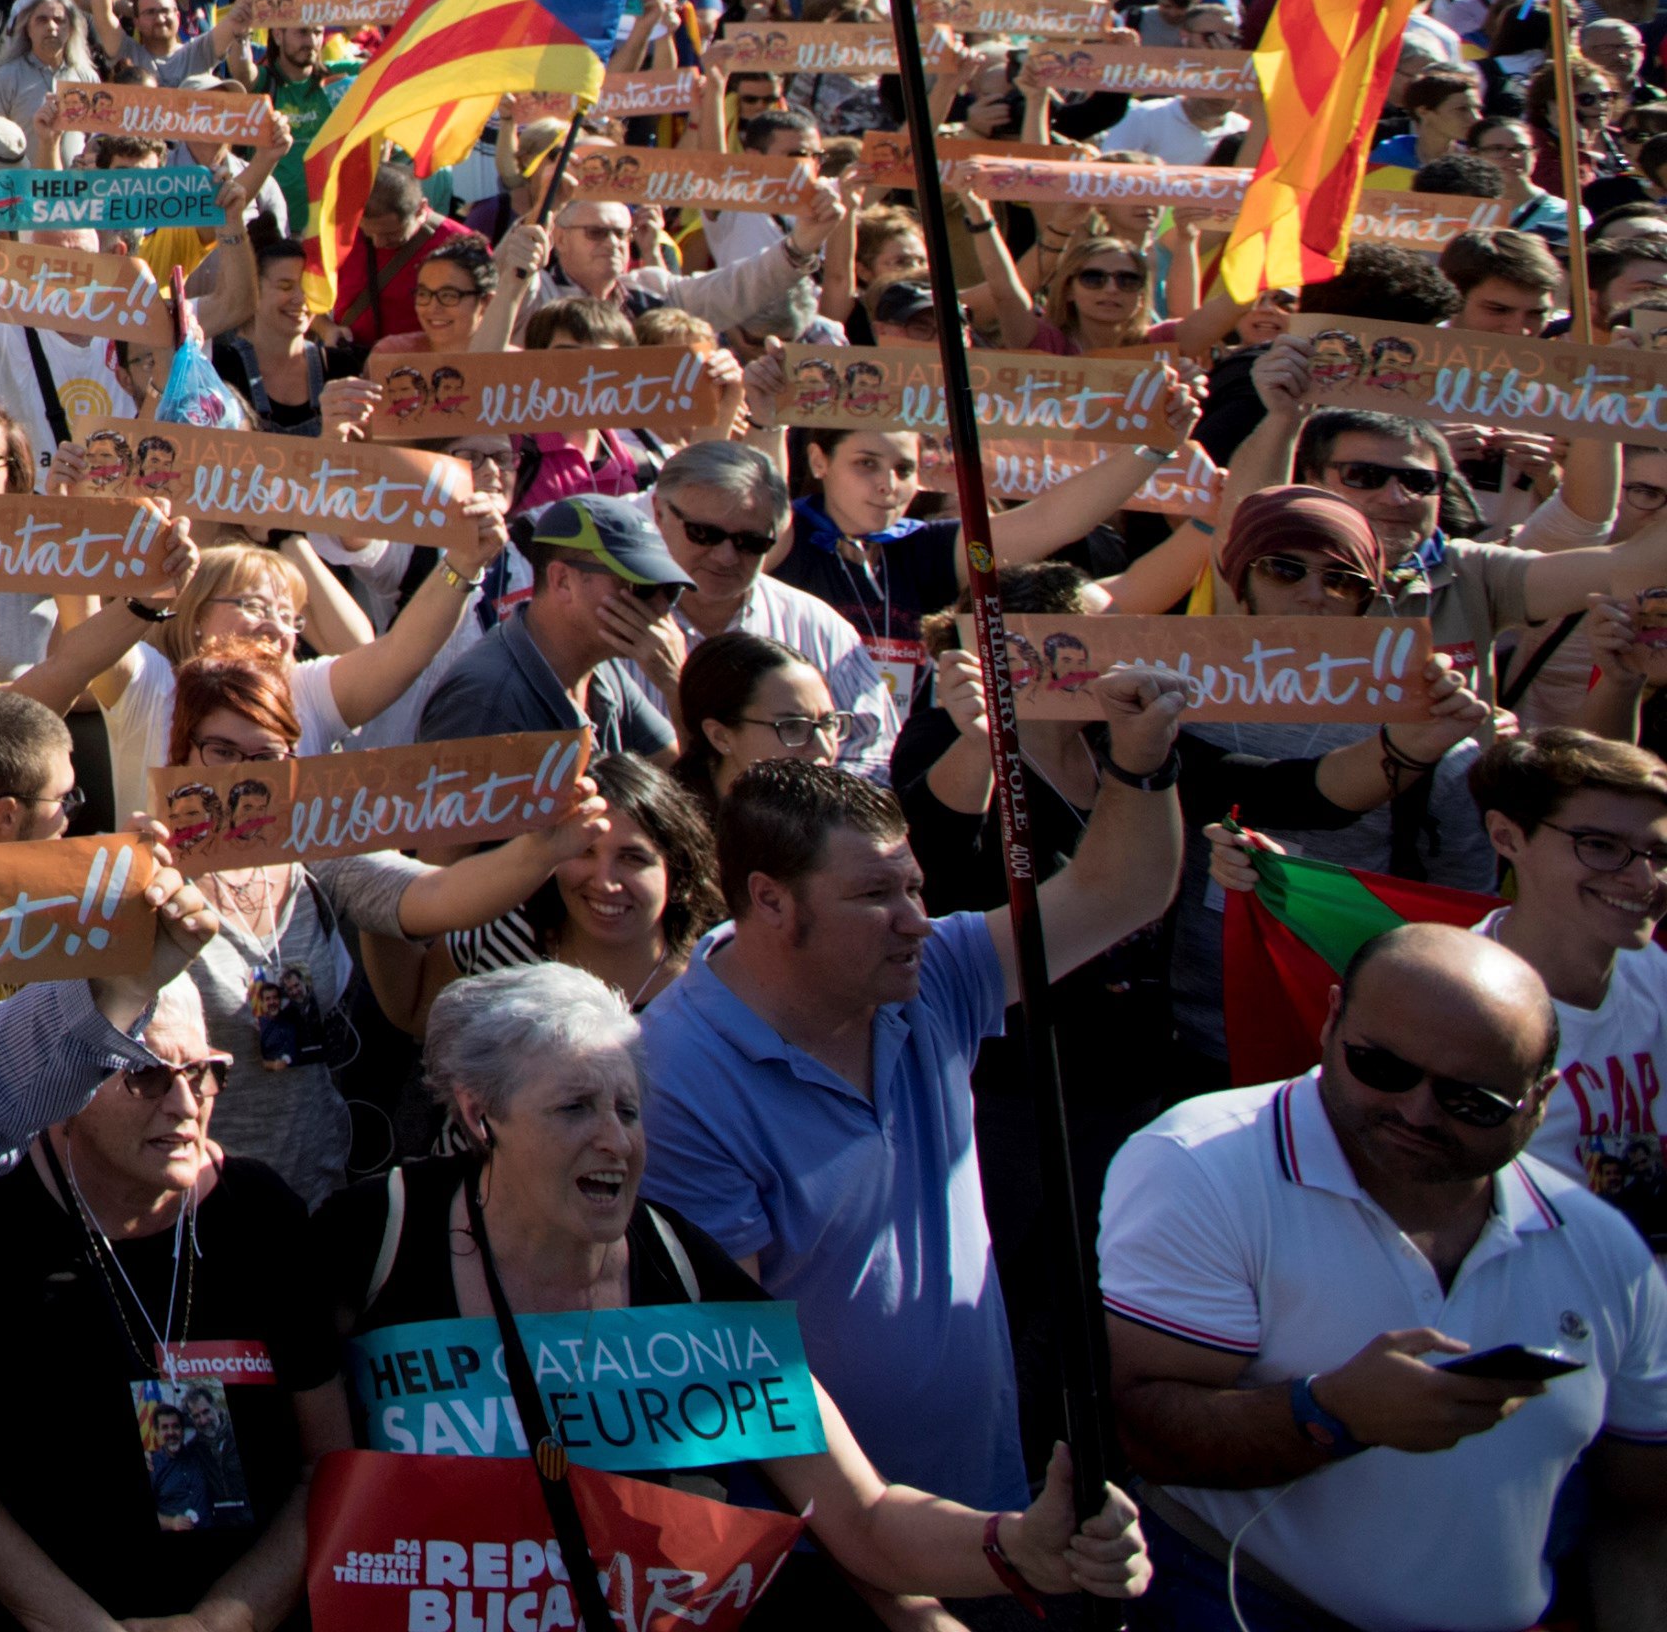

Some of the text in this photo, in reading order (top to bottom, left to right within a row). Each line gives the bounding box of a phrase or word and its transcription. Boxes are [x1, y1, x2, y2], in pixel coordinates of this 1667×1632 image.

[797, 27, 949, 68] lliberta!!
[120, 99, 267, 138] llibertat!!
[31, 177, 211, 196] HELP CATALONIA
[645, 166, 808, 206] llibertat!!
[31, 194, 213, 222] SAVE EUROPE
[478, 354, 703, 426] llibertat!!
[895, 370, 1166, 428] lliertat!!
[189, 458, 458, 528] llibertat!!
[985, 594, 1033, 880] PRIMARY POLE 4004
[283, 740, 579, 851] llibertat!!
[370, 1344, 480, 1400] HELP
[551, 1377, 797, 1448] EUROPE
[346, 1551, 421, 1570] SOSTRE
[394, 1539, 421, 1555] PA
[333, 1565, 420, 1585] TREBALL
